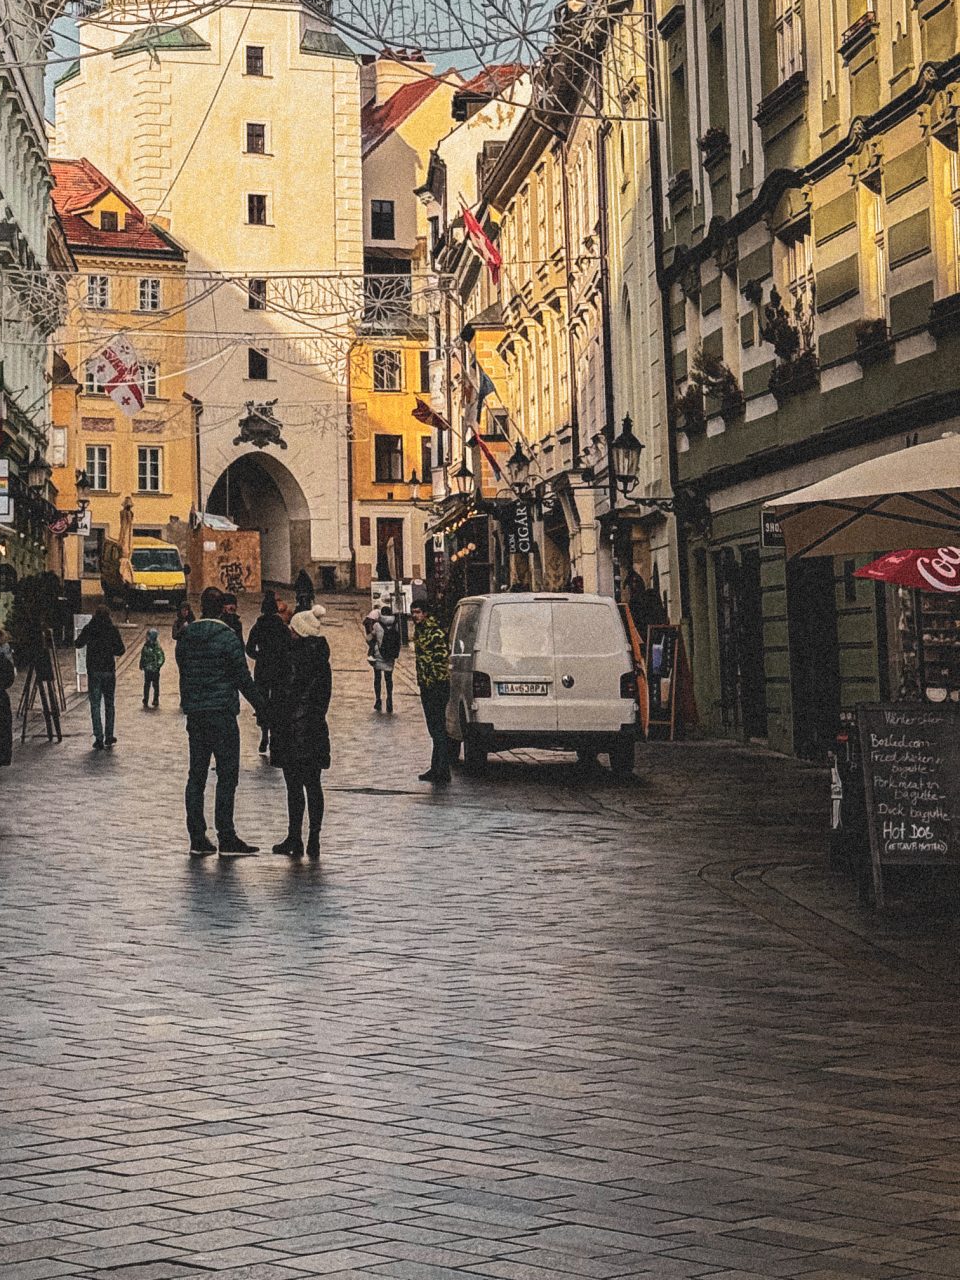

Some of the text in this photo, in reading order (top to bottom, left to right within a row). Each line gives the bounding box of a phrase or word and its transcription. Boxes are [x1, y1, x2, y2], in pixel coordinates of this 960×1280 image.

[870, 733, 907, 748] Boiled
[877, 803, 906, 817] Duck
[882, 821, 906, 840] Hot
